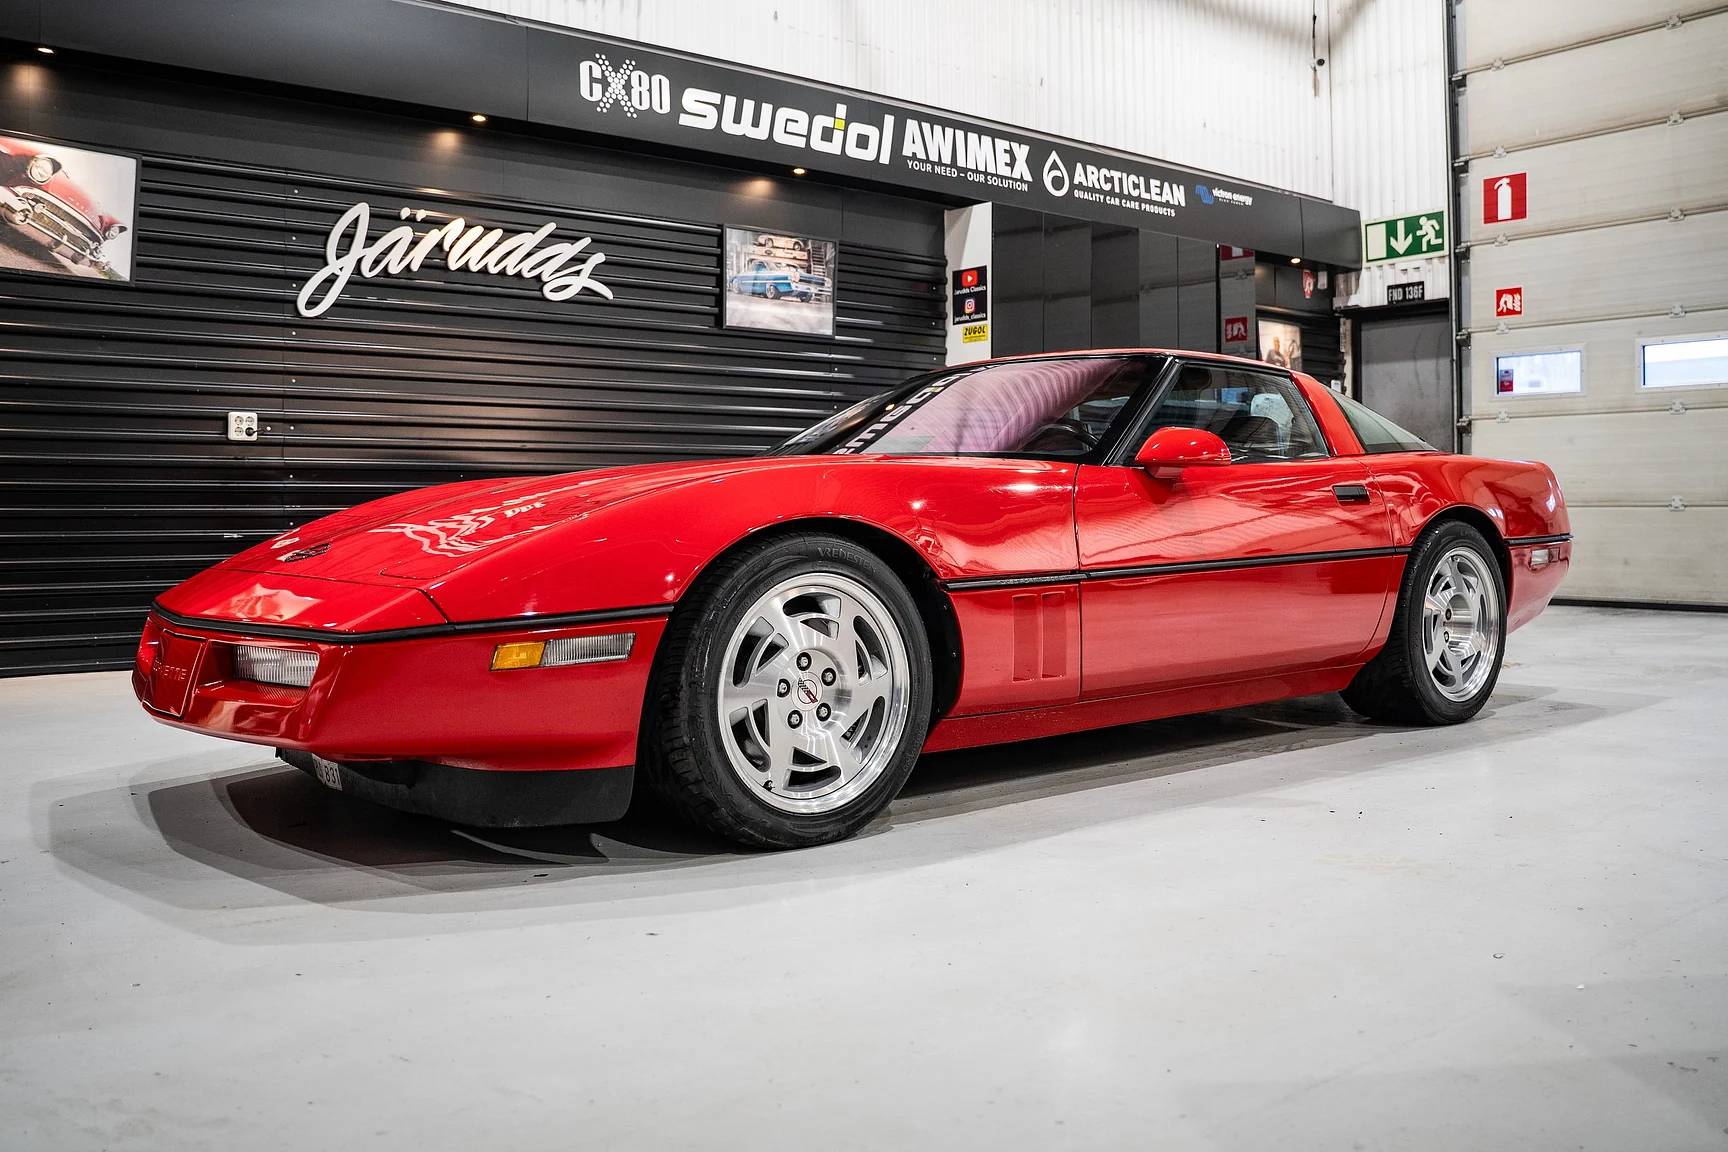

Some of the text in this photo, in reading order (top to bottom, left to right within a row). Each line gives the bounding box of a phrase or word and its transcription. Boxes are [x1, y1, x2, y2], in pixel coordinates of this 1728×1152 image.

[580, 53, 671, 118] CX80
[678, 87, 895, 165] swedol
[902, 118, 1033, 183] AWIMEX
[907, 160, 933, 173] YOUR
[935, 165, 958, 178] NEED
[967, 171, 986, 184] OUR
[987, 176, 1028, 192] SOLUTION
[1073, 162, 1186, 207] ARCTICLEAN
[1074, 189, 1176, 218] QUALITY CAR CARE PRODUCTS
[297, 202, 614, 318] Järudds
[1388, 285, 1423, 302] FND 136F
[964, 326, 985, 336] ZUGOL
